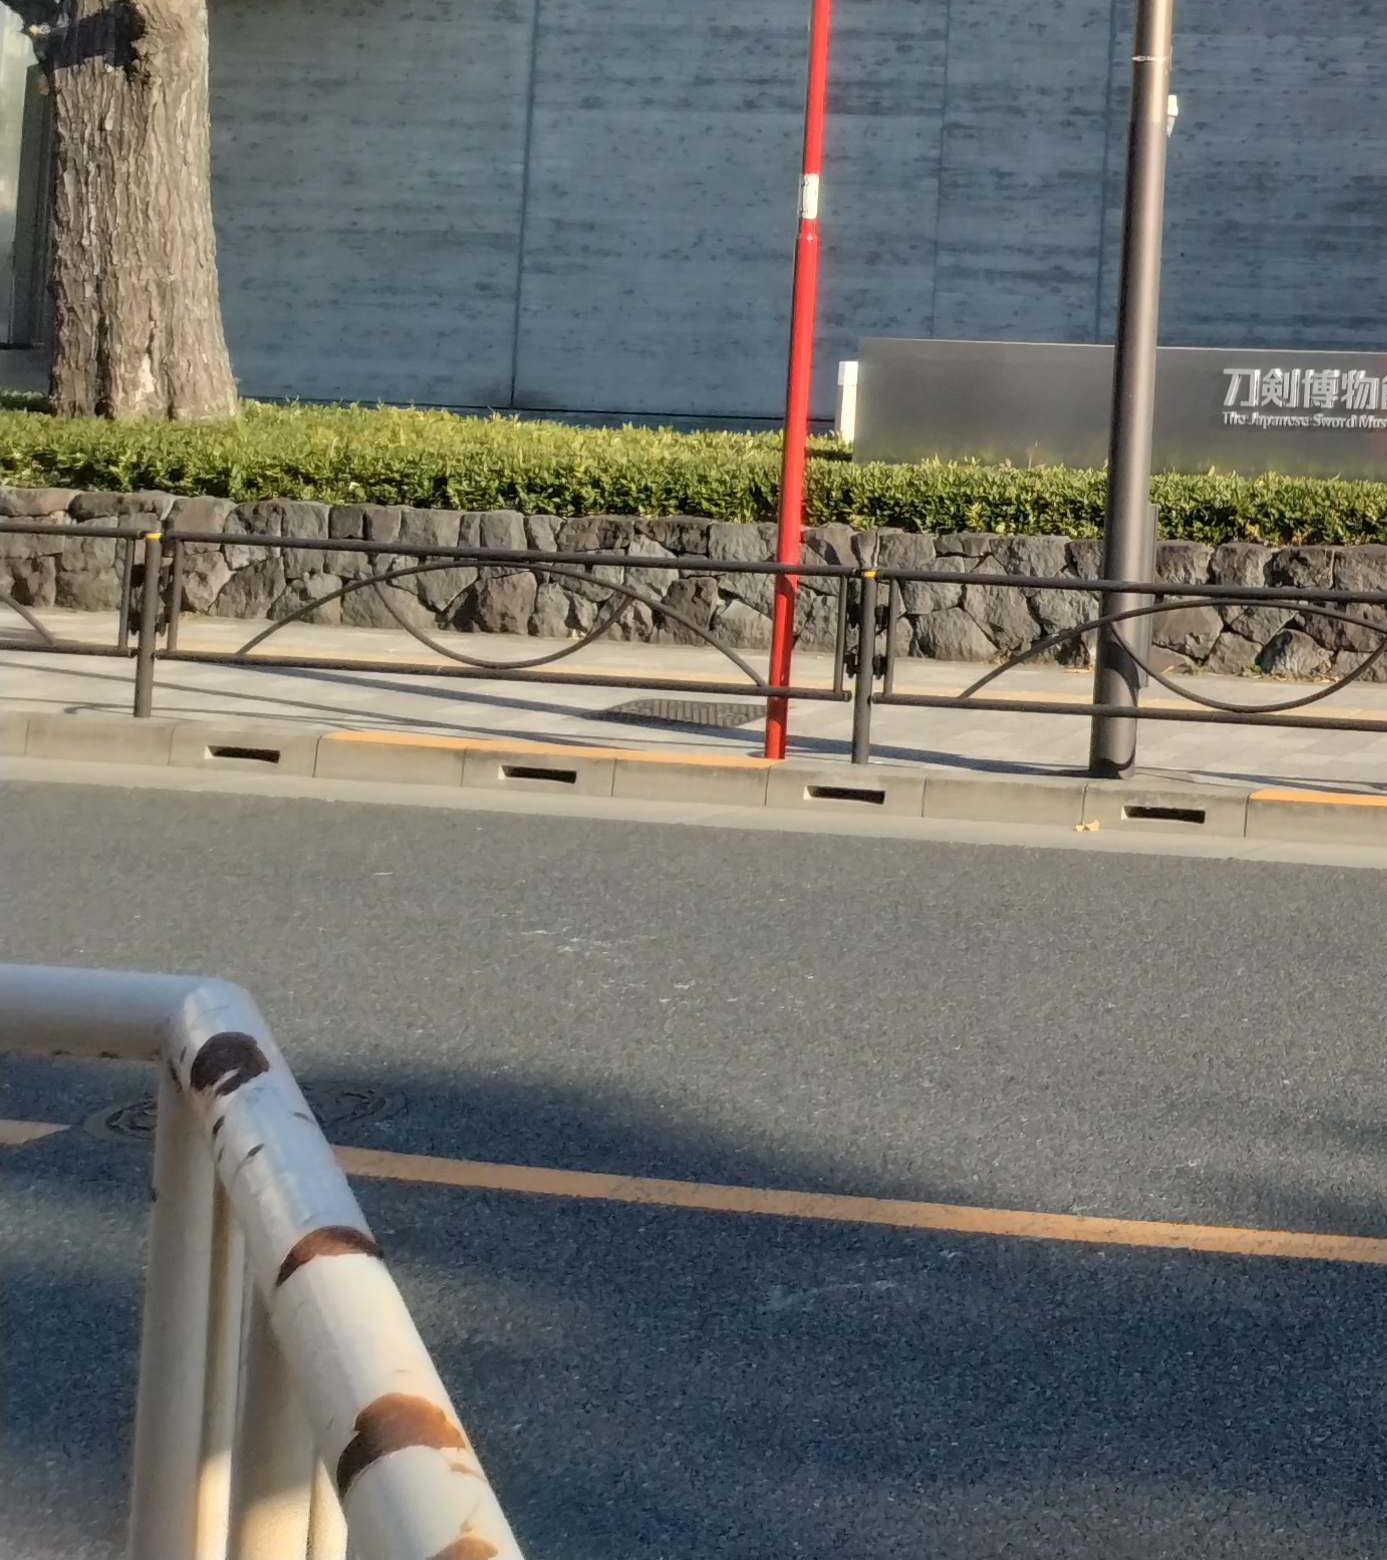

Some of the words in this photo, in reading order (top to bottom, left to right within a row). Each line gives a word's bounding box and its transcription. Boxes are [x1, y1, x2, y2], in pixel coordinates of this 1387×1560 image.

[1222, 410, 1248, 425] The
[1248, 411, 1311, 430] Japanese
[1312, 413, 1358, 429] Sword
